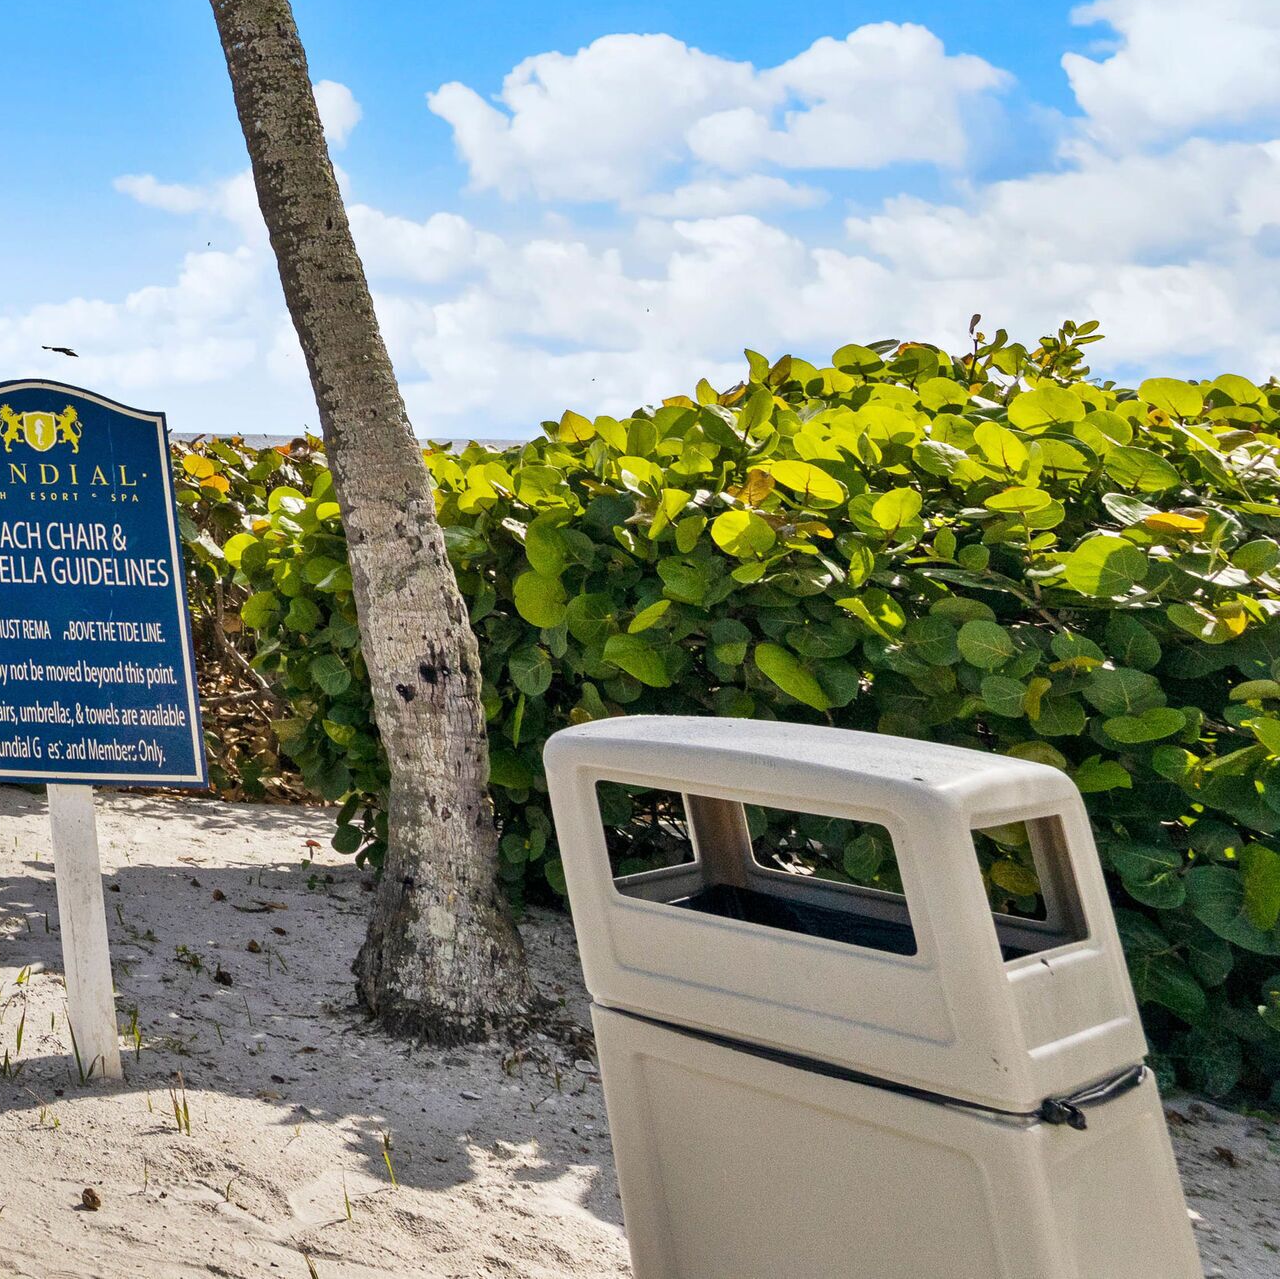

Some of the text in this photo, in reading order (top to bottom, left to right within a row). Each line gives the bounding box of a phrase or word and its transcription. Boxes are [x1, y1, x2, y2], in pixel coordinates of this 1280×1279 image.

[30, 492, 78, 501] ESORT
[111, 494, 139, 502] SPA
[46, 522, 108, 551] CHAIR
[112, 524, 126, 552] &
[51, 557, 169, 586] GUIDELINES
[22, 620, 52, 640] REMA
[96, 622, 118, 642] THE
[117, 622, 140, 642] TIDE
[142, 623, 166, 642] LINE.
[10, 661, 29, 680] not
[29, 659, 44, 681] be
[46, 660, 82, 682] moved
[83, 660, 124, 688] beyond
[124, 661, 145, 684] this
[146, 663, 178, 689] point.
[20, 700, 74, 728] umbrellas,
[75, 705, 85, 724] &
[85, 702, 120, 725] towels
[122, 708, 139, 726] are
[140, 703, 186, 727] available
[66, 737, 86, 760] and
[87, 738, 137, 761] Members
[138, 739, 166, 768] Only.
